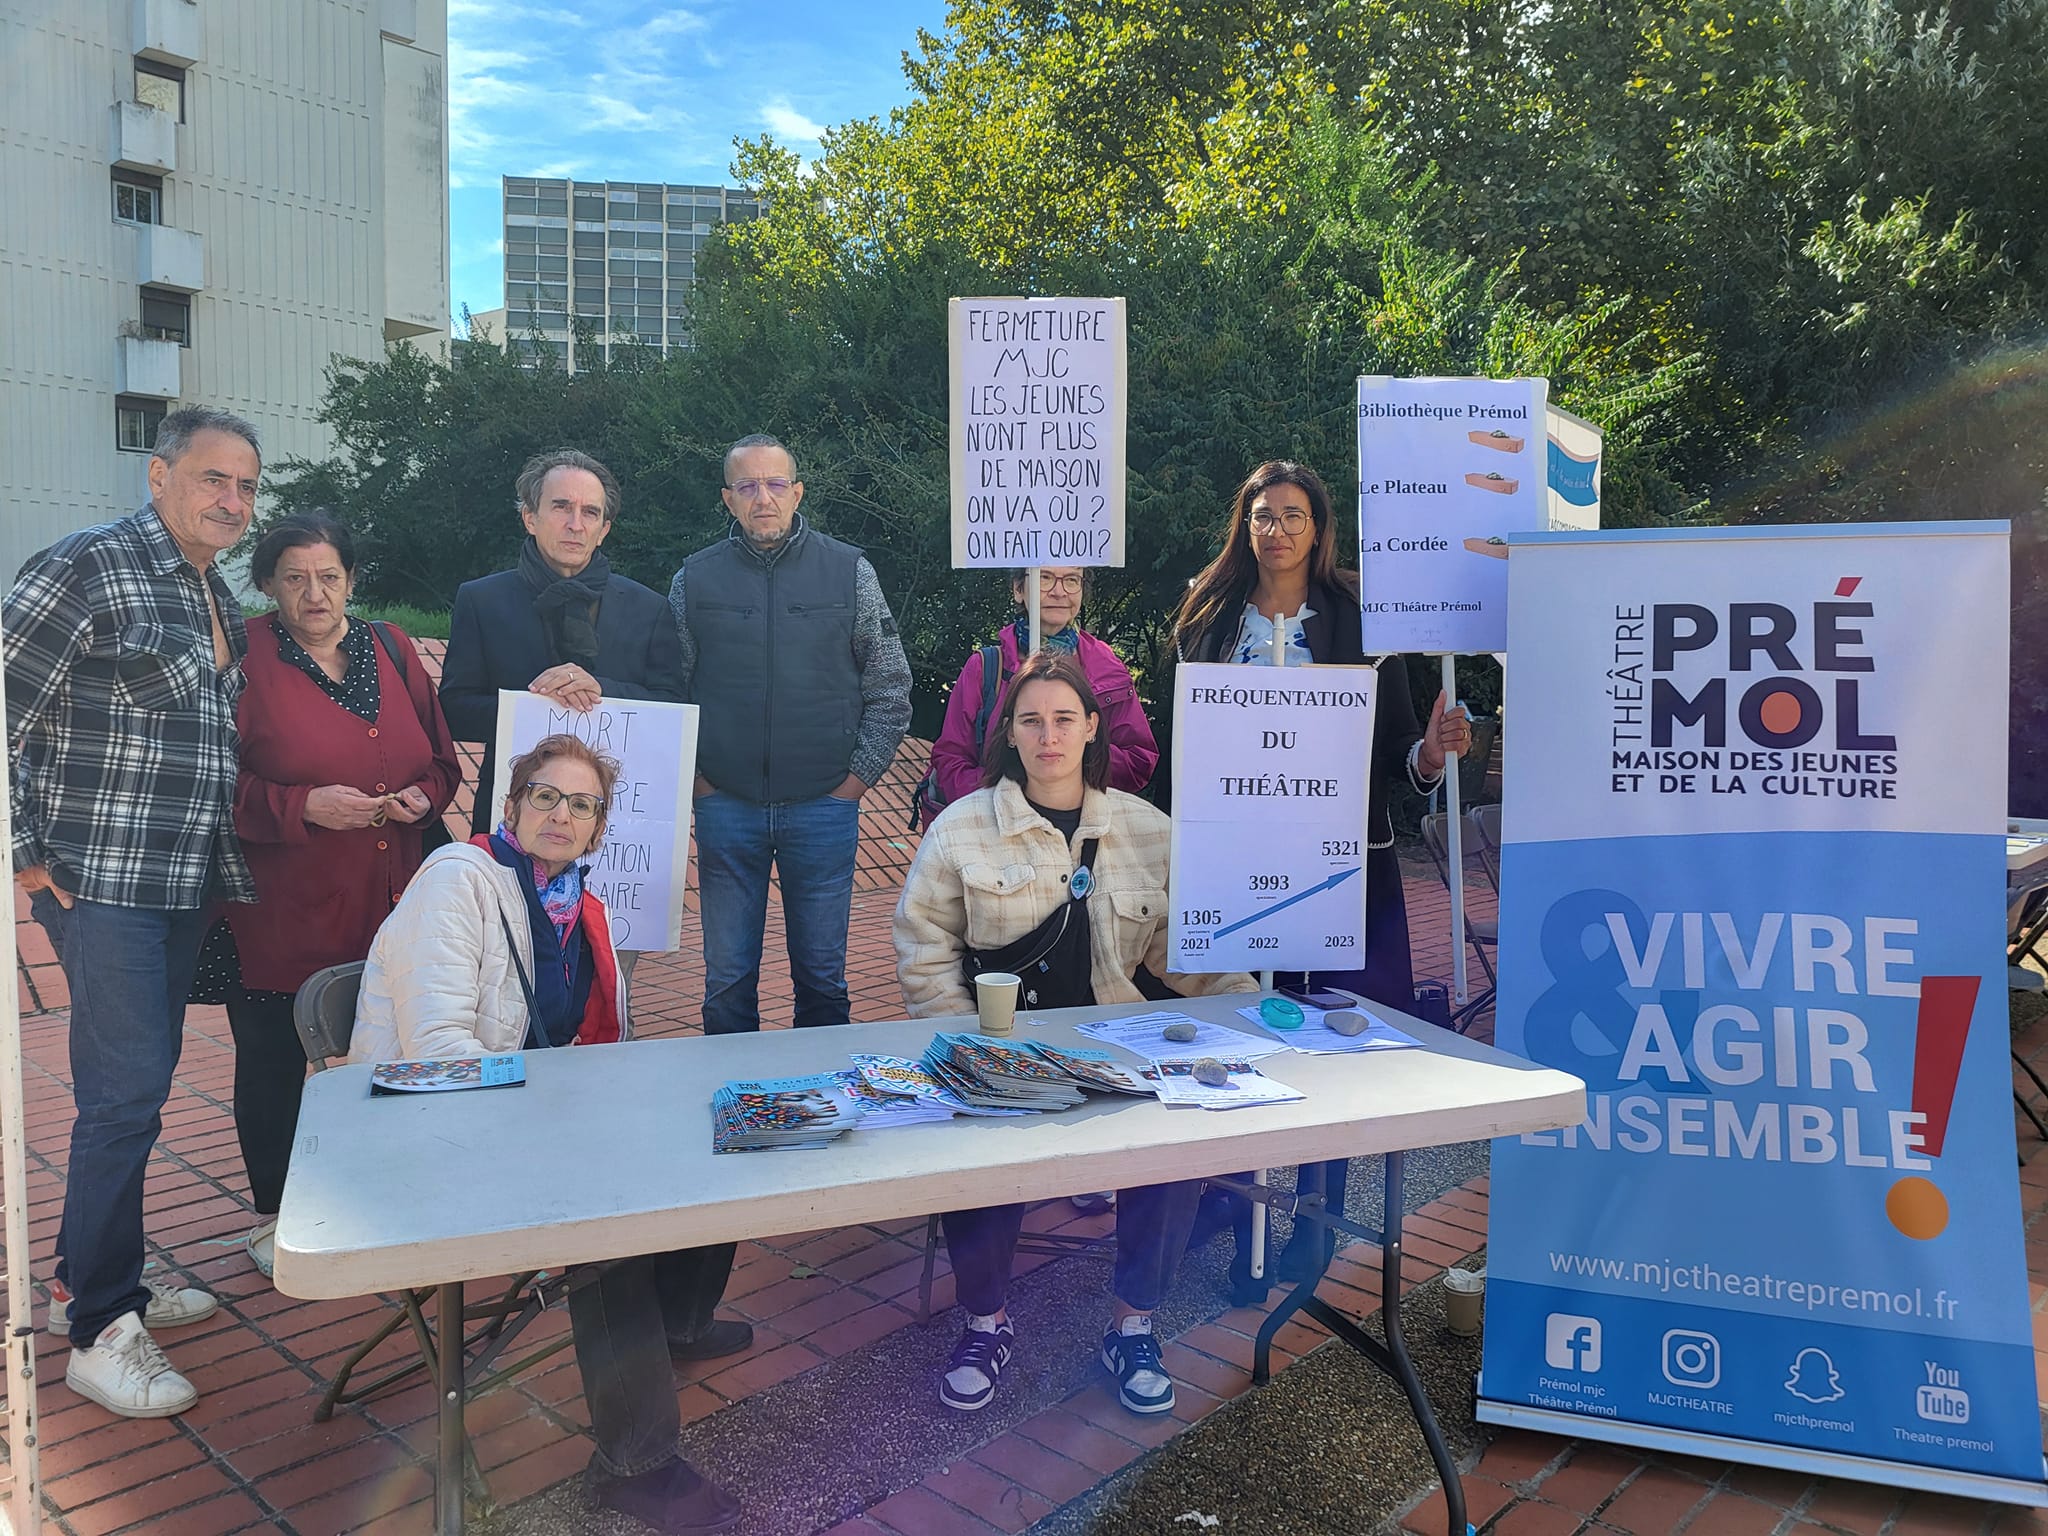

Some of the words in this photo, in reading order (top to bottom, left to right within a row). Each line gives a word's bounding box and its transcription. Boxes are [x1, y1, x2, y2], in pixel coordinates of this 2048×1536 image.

[968, 309, 1106, 342] FERMETURE
[993, 347, 1069, 379] MJC
[970, 385, 1007, 416] LES
[1011, 383, 1106, 415] JEUNES
[1358, 403, 1463, 421] Bibliothèque
[1467, 404, 1529, 420] Prémol
[966, 421, 1028, 452] N'ONT
[1040, 420, 1098, 451] PLUS
[980, 458, 1007, 489] DE
[1359, 480, 1380, 495] Le
[1384, 479, 1448, 494] Plateau
[967, 495, 995, 524] ON
[1005, 495, 1038, 523] VA
[1048, 489, 1079, 523] OÙ
[967, 530, 996, 559] ON
[1361, 538, 1382, 553] La
[1387, 536, 1449, 552] Cordée
[1361, 602, 1389, 613] MJC
[1392, 601, 1438, 613] Théâtre
[1440, 600, 1483, 612] Prémol
[1652, 576, 1876, 673] PRÉ
[1606, 603, 1645, 748] THÉÂTRE
[1190, 685, 1369, 708] FRÉQUENTATION
[1650, 676, 1898, 751] MOL
[547, 707, 638, 753] MORT
[1261, 730, 1297, 750] DU
[1611, 751, 1720, 770] MAISON
[1730, 751, 1784, 771] DES
[1790, 752, 1898, 774] JEUNES
[1219, 773, 1339, 798] THÉÂTRE
[1611, 774, 1645, 793] ET
[1659, 774, 1696, 793] DE
[1711, 775, 1747, 794] LA
[1761, 775, 1898, 800] CULTURE
[1321, 840, 1361, 857] 5321
[1248, 875, 1290, 891] 3993
[1181, 910, 1223, 926] 1305
[1180, 937, 1211, 950] 2021
[1247, 936, 1280, 950] 2022
[1324, 935, 1355, 949] 2023
[1604, 912, 1922, 999] VIVRE
[1616, 1004, 1878, 1093] AGIR
[1520, 1094, 1933, 1171] NSEMBLE
[1549, 1249, 1960, 1322] www.mjctheatrepremol.fr
[1924, 1360, 1960, 1388] You
[1539, 1376, 1580, 1395] Prémol
[1584, 1383, 1606, 1399] mjc
[1528, 1393, 1573, 1411] Théâtre
[1575, 1400, 1617, 1417] Prémol
[1648, 1392, 1735, 1416] MJCTHEATRE
[1919, 1389, 1967, 1419] Tube
[1774, 1411, 1855, 1433] mjcthpremol
[1893, 1427, 1944, 1446] Theatre
[1946, 1436, 1995, 1453] premol
